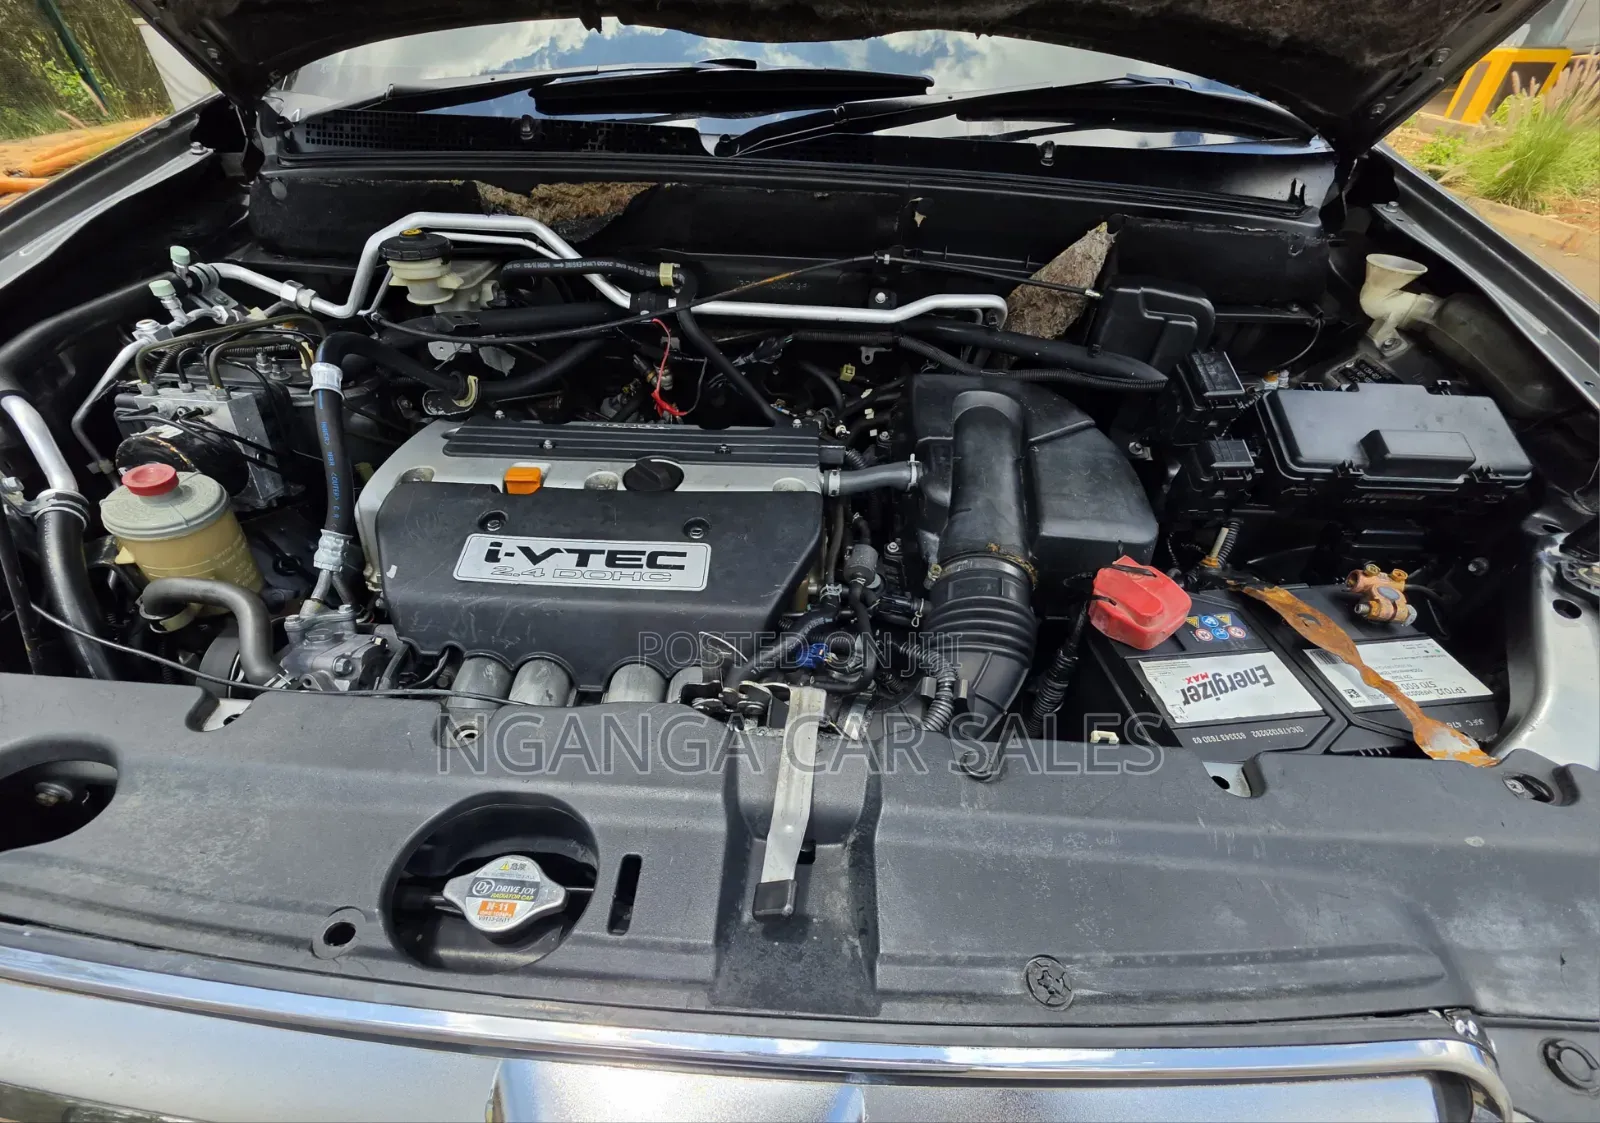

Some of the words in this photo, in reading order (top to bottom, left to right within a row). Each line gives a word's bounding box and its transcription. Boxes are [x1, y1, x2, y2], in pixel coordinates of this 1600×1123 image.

[326, 451, 335, 467] NBR
[484, 541, 688, 571] i-VTEC
[490, 565, 546, 579] 2.4
[552, 568, 672, 583] DOHC
[1179, 664, 1275, 707] Energizer
[1185, 671, 1210, 685] MAX
[490, 892, 520, 900] RADIATOR
[495, 884, 521, 894] DRIVE
[521, 887, 537, 895] JOY
